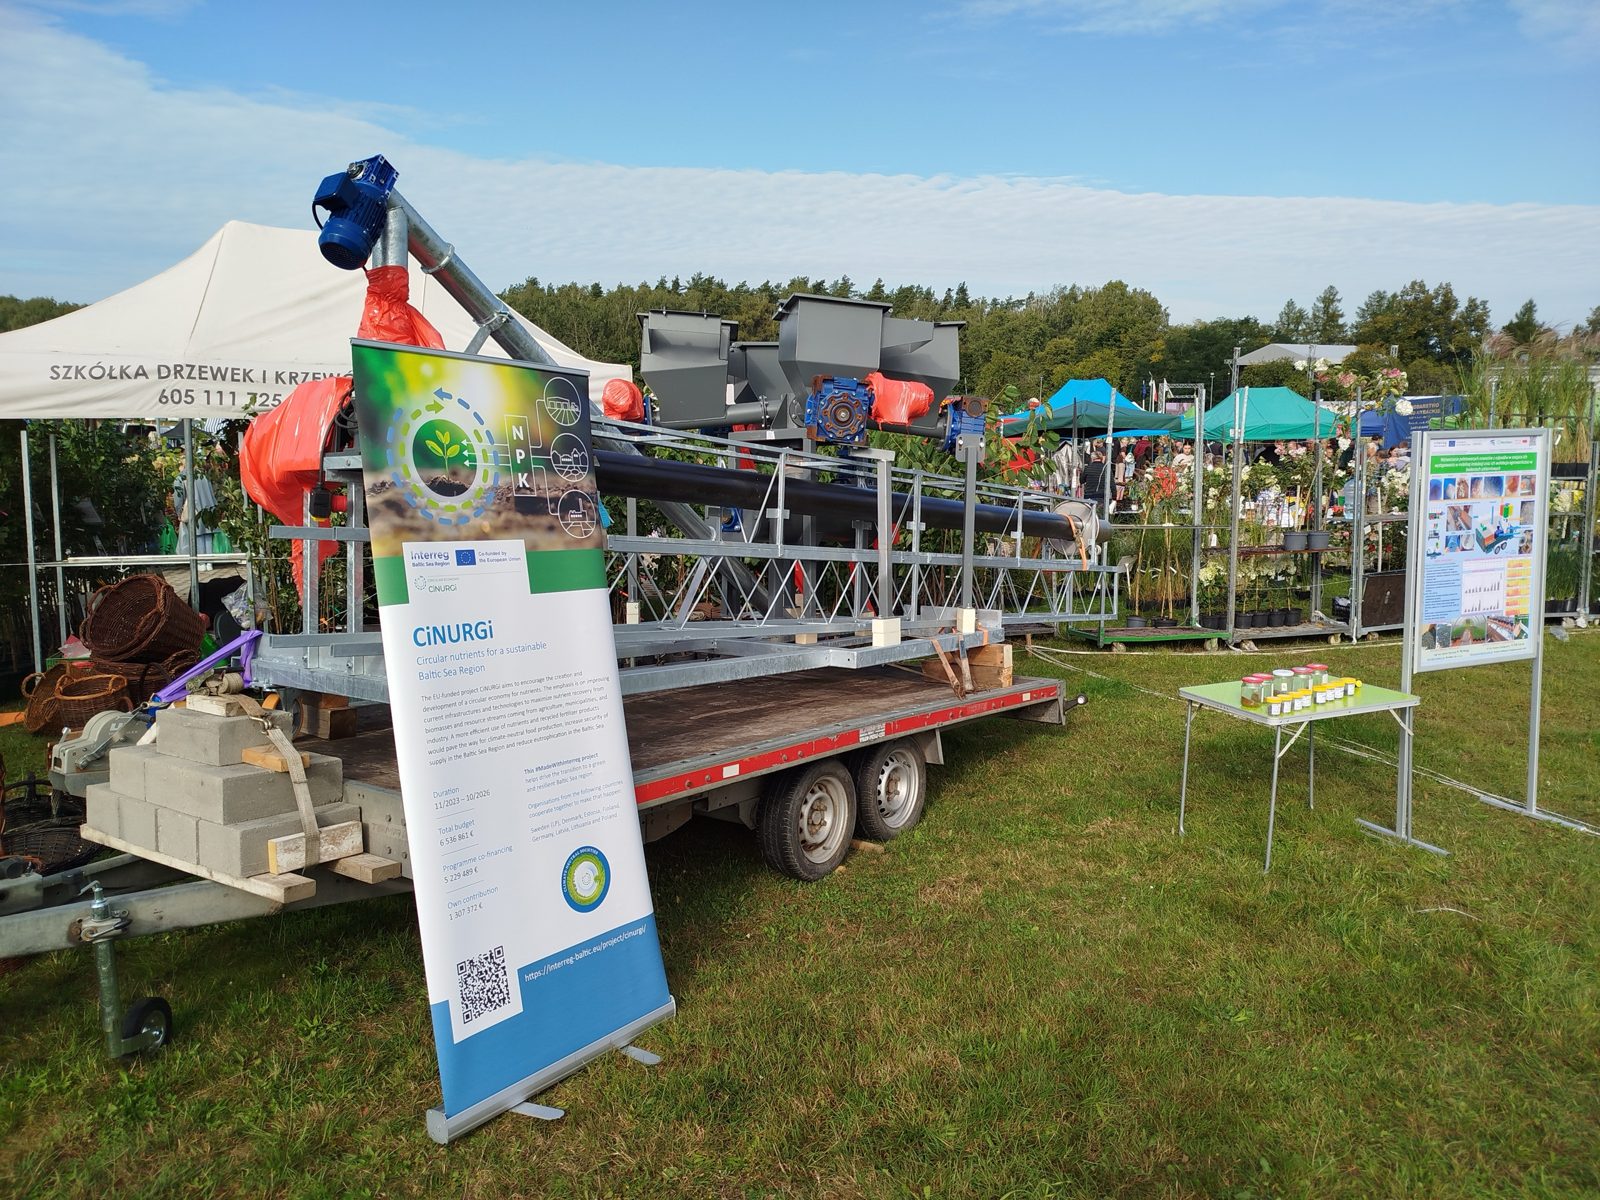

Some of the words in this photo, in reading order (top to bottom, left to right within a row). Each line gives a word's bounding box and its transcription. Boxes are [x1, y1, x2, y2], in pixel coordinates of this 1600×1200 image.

[50, 362, 149, 380] SZKÓŁKA
[157, 364, 254, 383] DRZEWEK
[262, 370, 266, 384] I
[158, 388, 194, 404] 605
[204, 390, 236, 406] 111
[512, 425, 524, 440] N
[516, 448, 525, 464] P
[518, 472, 530, 488] K
[411, 551, 450, 560] Interreg
[428, 584, 457, 592] CiNURGi
[413, 620, 494, 647] CiNURGi
[416, 655, 448, 666] Circular
[450, 650, 485, 661] nutrients
[486, 648, 497, 656] for
[506, 641, 547, 653] sustainable
[418, 670, 441, 680] Baltic
[443, 668, 457, 677] Sea
[459, 664, 485, 676] Region
[423, 702, 457, 712] development
[488, 693, 510, 701] economy
[433, 691, 460, 700] EU-funded
[540, 713, 558, 721] recycled
[425, 725, 452, 734] biomasses
[429, 758, 446, 766] supply
[534, 731, 567, 741] eutrophication
[433, 787, 459, 798] Duration
[435, 798, 460, 809] 11/2023
[466, 789, 490, 802] 10/2026
[439, 826, 454, 834] Total
[455, 819, 475, 830] budget
[443, 858, 477, 872] Programme
[478, 845, 512, 861] co-financing
[450, 872, 461, 882] 229
[462, 869, 473, 878] 489
[448, 901, 462, 909] Own
[463, 886, 498, 903] contribution
[455, 909, 465, 918] 307
[467, 905, 478, 914] 372
[524, 924, 647, 982] https://interreg-baltic.eu/project/cinurgi/
